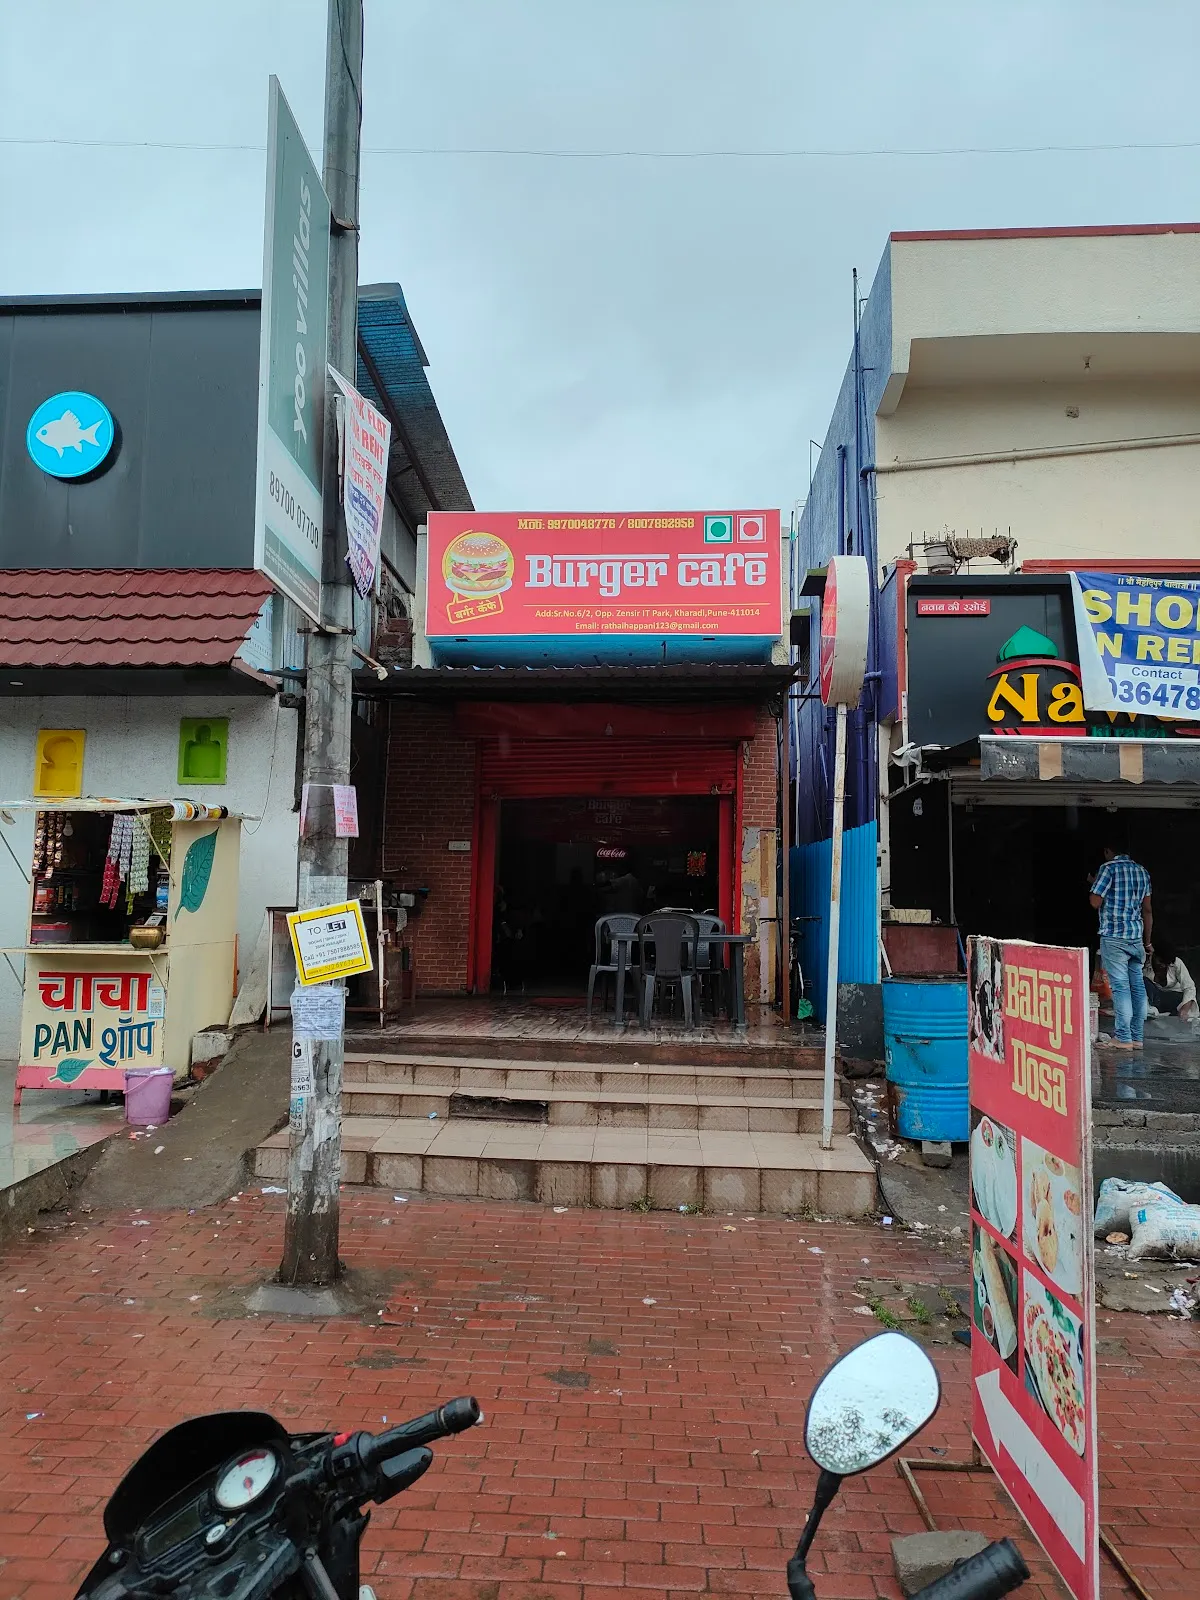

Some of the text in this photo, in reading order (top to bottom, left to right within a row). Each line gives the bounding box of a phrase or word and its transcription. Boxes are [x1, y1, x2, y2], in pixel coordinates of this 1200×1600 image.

[293, 176, 311, 444] yoo villas
[269, 471, 295, 521] 89700
[296, 504, 319, 550] 07700
[524, 552, 769, 597] Burger cafe
[594, 608, 614, 620] Opp.
[641, 607, 651, 618] IT
[652, 607, 673, 619] Park,
[1131, 666, 1183, 681] Contact
[307, 926, 322, 936] TO
[303, 953, 315, 962] Call
[38, 972, 153, 1012] चाचा
[1004, 964, 1073, 1050] Balaji
[34, 1017, 156, 1067] PAN शॉप
[1011, 1037, 1069, 1117] Dosa
